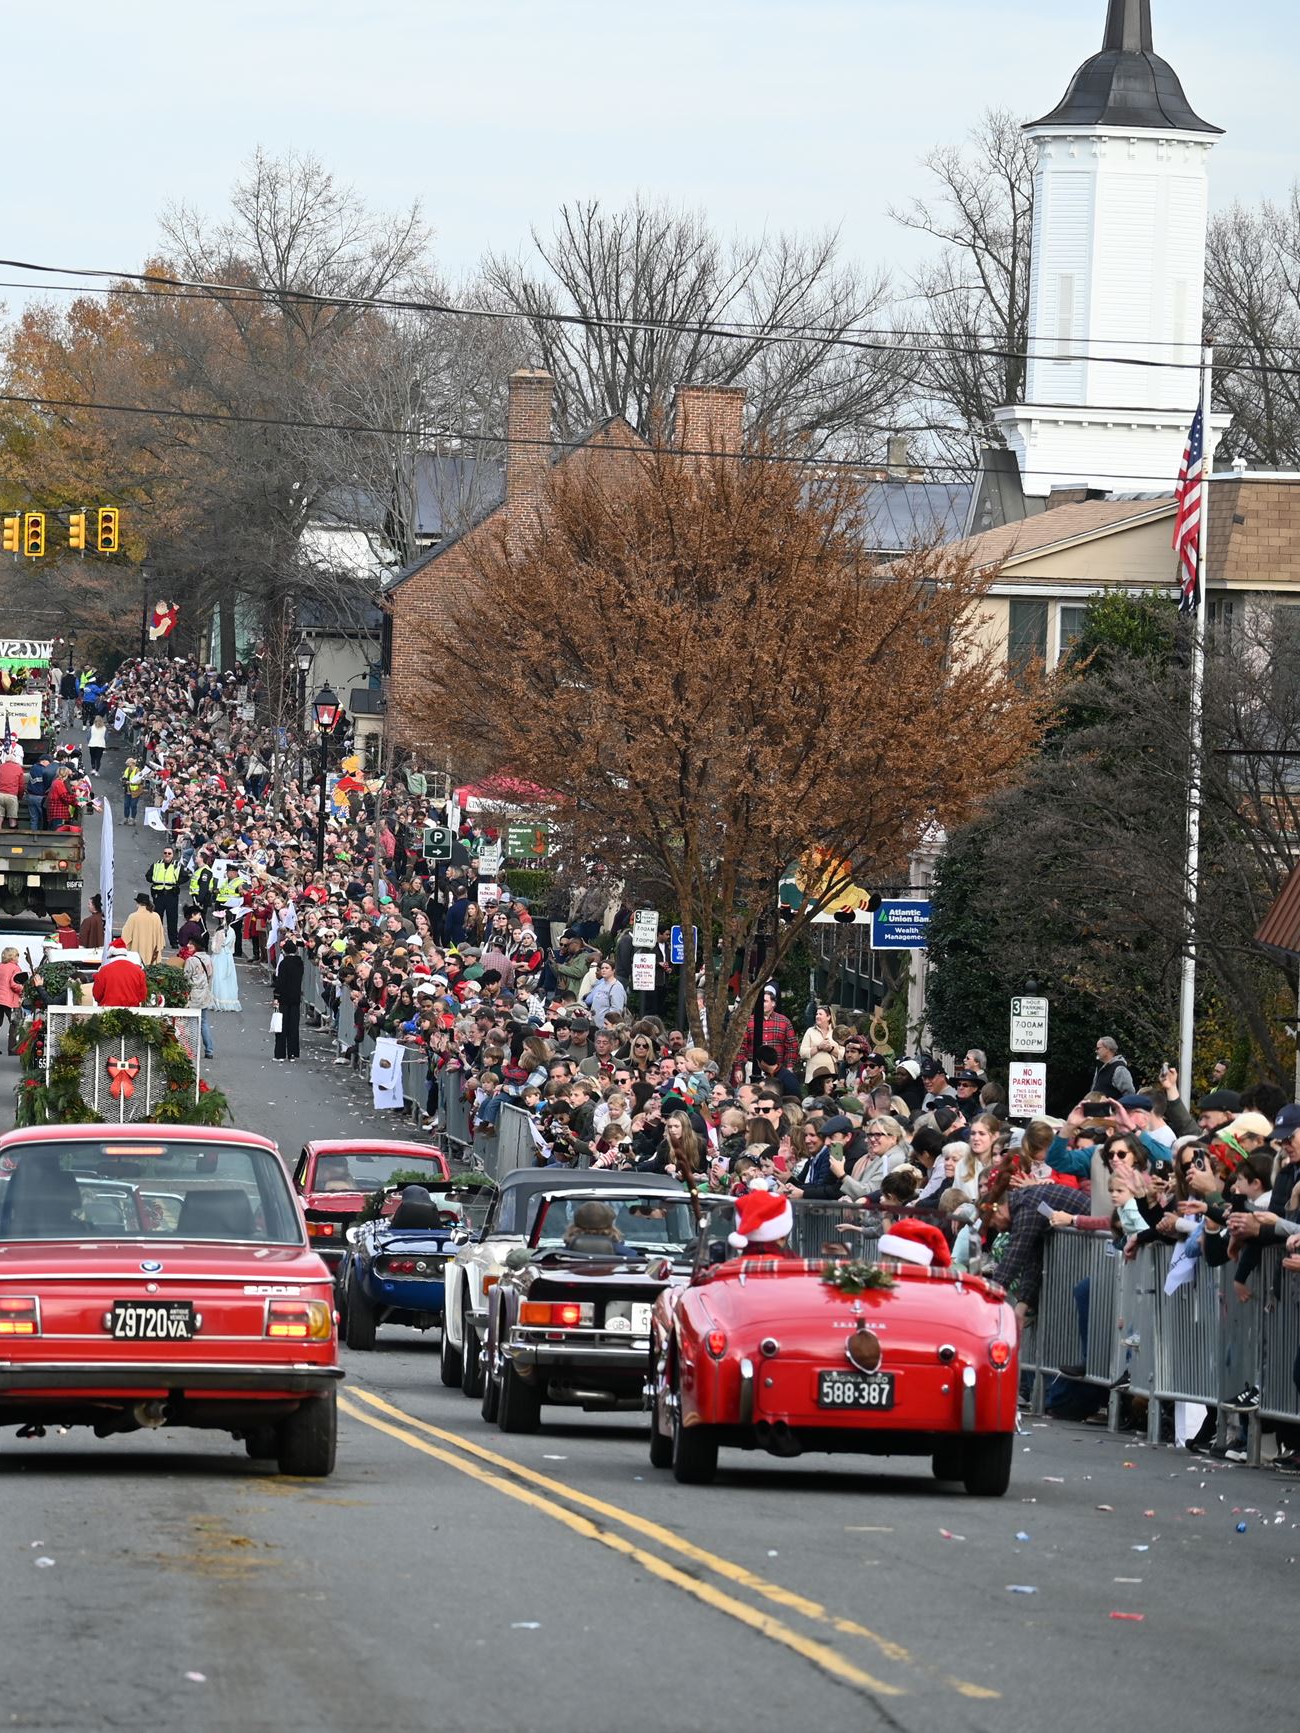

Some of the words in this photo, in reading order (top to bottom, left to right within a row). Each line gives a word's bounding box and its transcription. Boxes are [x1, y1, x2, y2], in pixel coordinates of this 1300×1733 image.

[434, 832, 443, 842] P
[1013, 1000, 1020, 1014] 3
[1022, 1068, 1033, 1076] NO
[1012, 1077, 1043, 1086] PARKING
[243, 1285, 301, 1295] 2002
[115, 1308, 168, 1337] Z9720
[612, 1321, 625, 1330] GB
